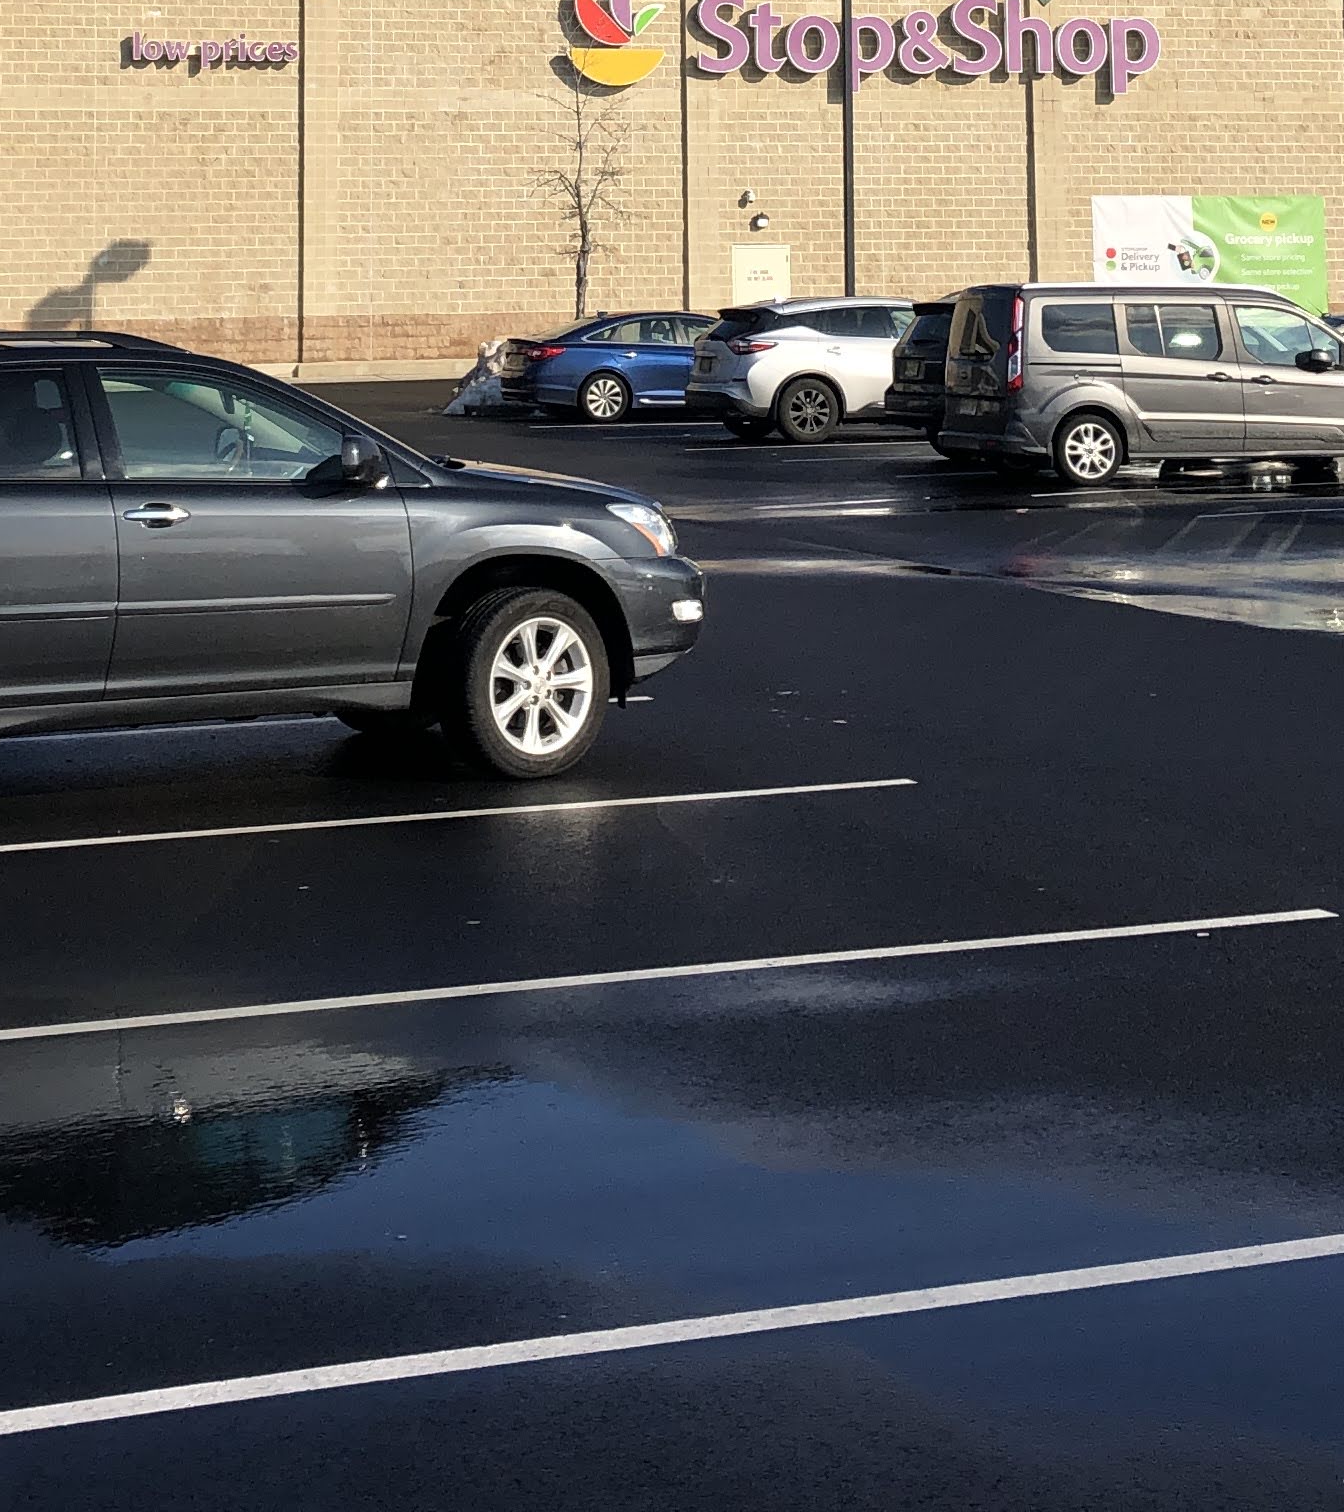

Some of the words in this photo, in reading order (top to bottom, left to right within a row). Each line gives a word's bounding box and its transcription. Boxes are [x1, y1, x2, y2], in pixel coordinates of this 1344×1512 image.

[132, 31, 191, 61] low
[200, 33, 299, 68] prices
[1225, 232, 1272, 247] Grocery
[1274, 232, 1314, 247] pickup
[1121, 252, 1160, 263] Delivery
[1121, 262, 1128, 271] &
[1129, 262, 1161, 273] Pickup
